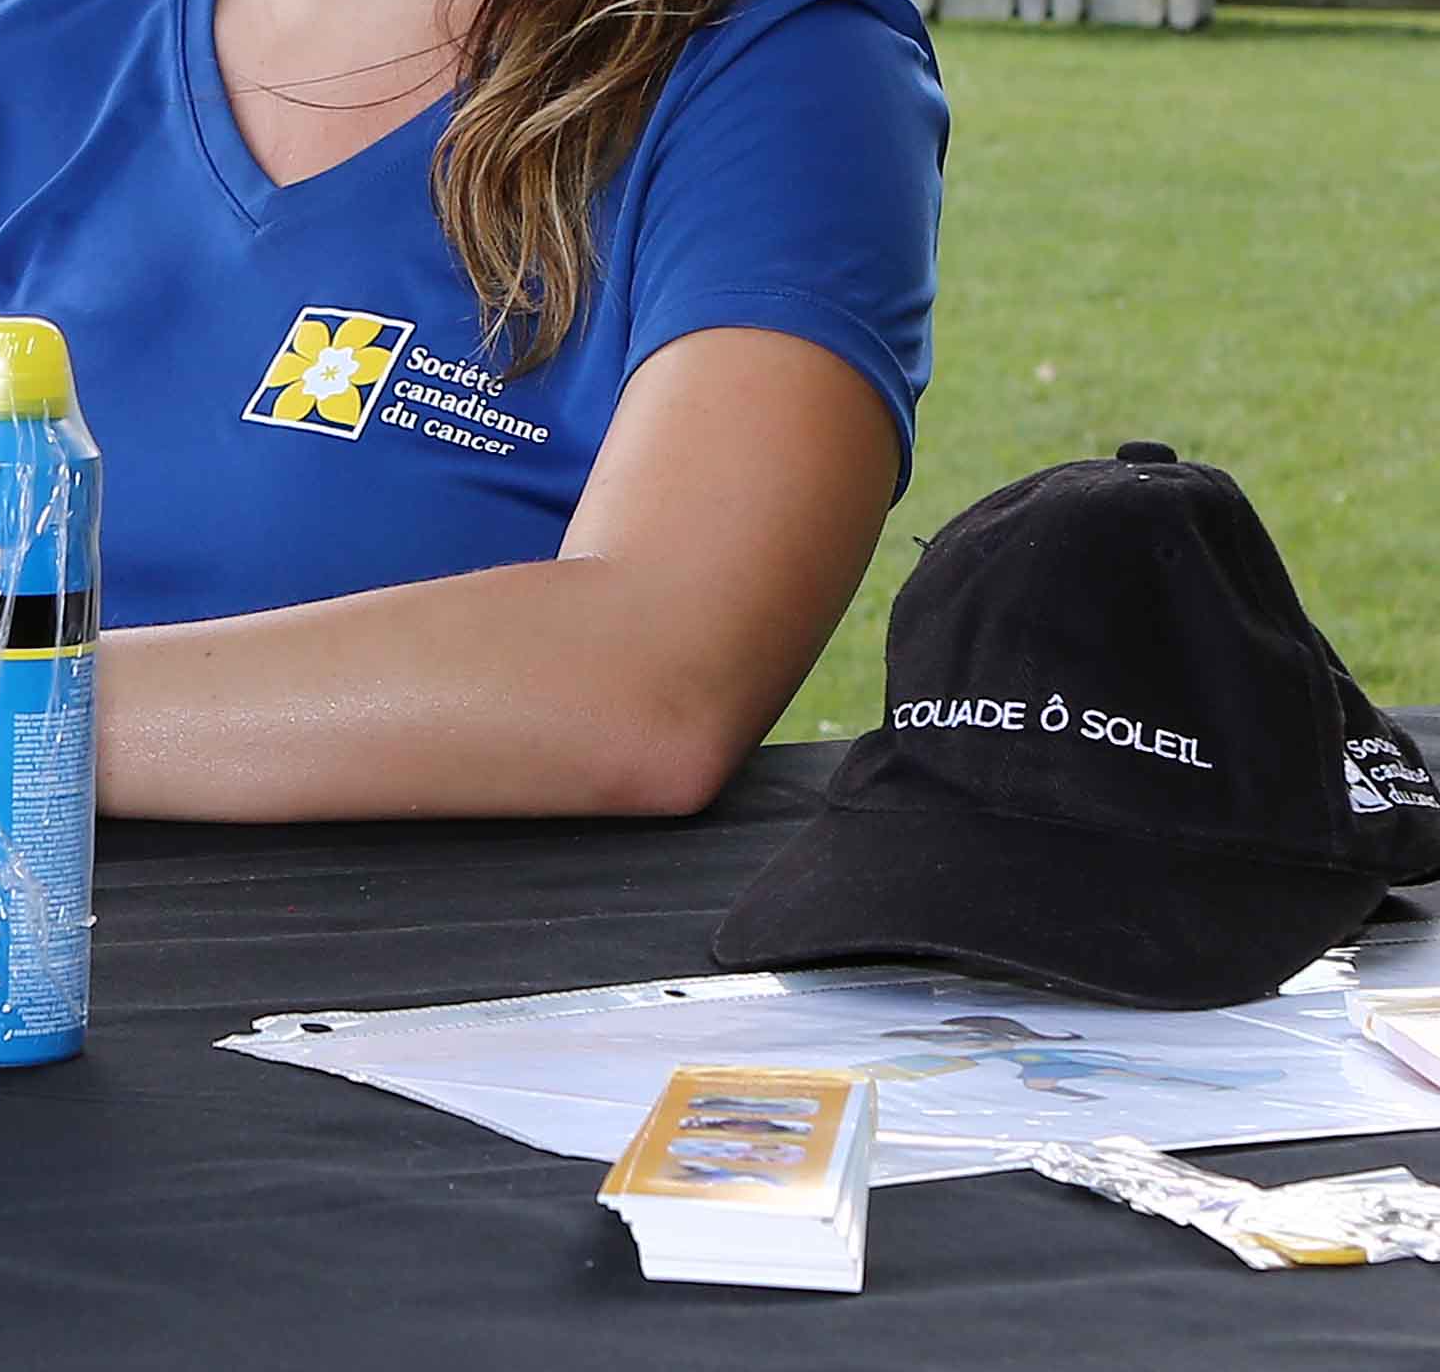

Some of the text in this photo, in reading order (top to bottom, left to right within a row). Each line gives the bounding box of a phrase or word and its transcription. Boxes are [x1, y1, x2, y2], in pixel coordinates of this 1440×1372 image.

[406, 346, 504, 398] Société
[380, 401, 516, 457] du cancer
[393, 379, 550, 444] canadienne
[892, 693, 1213, 770] COUADE Ô SOLEIL
